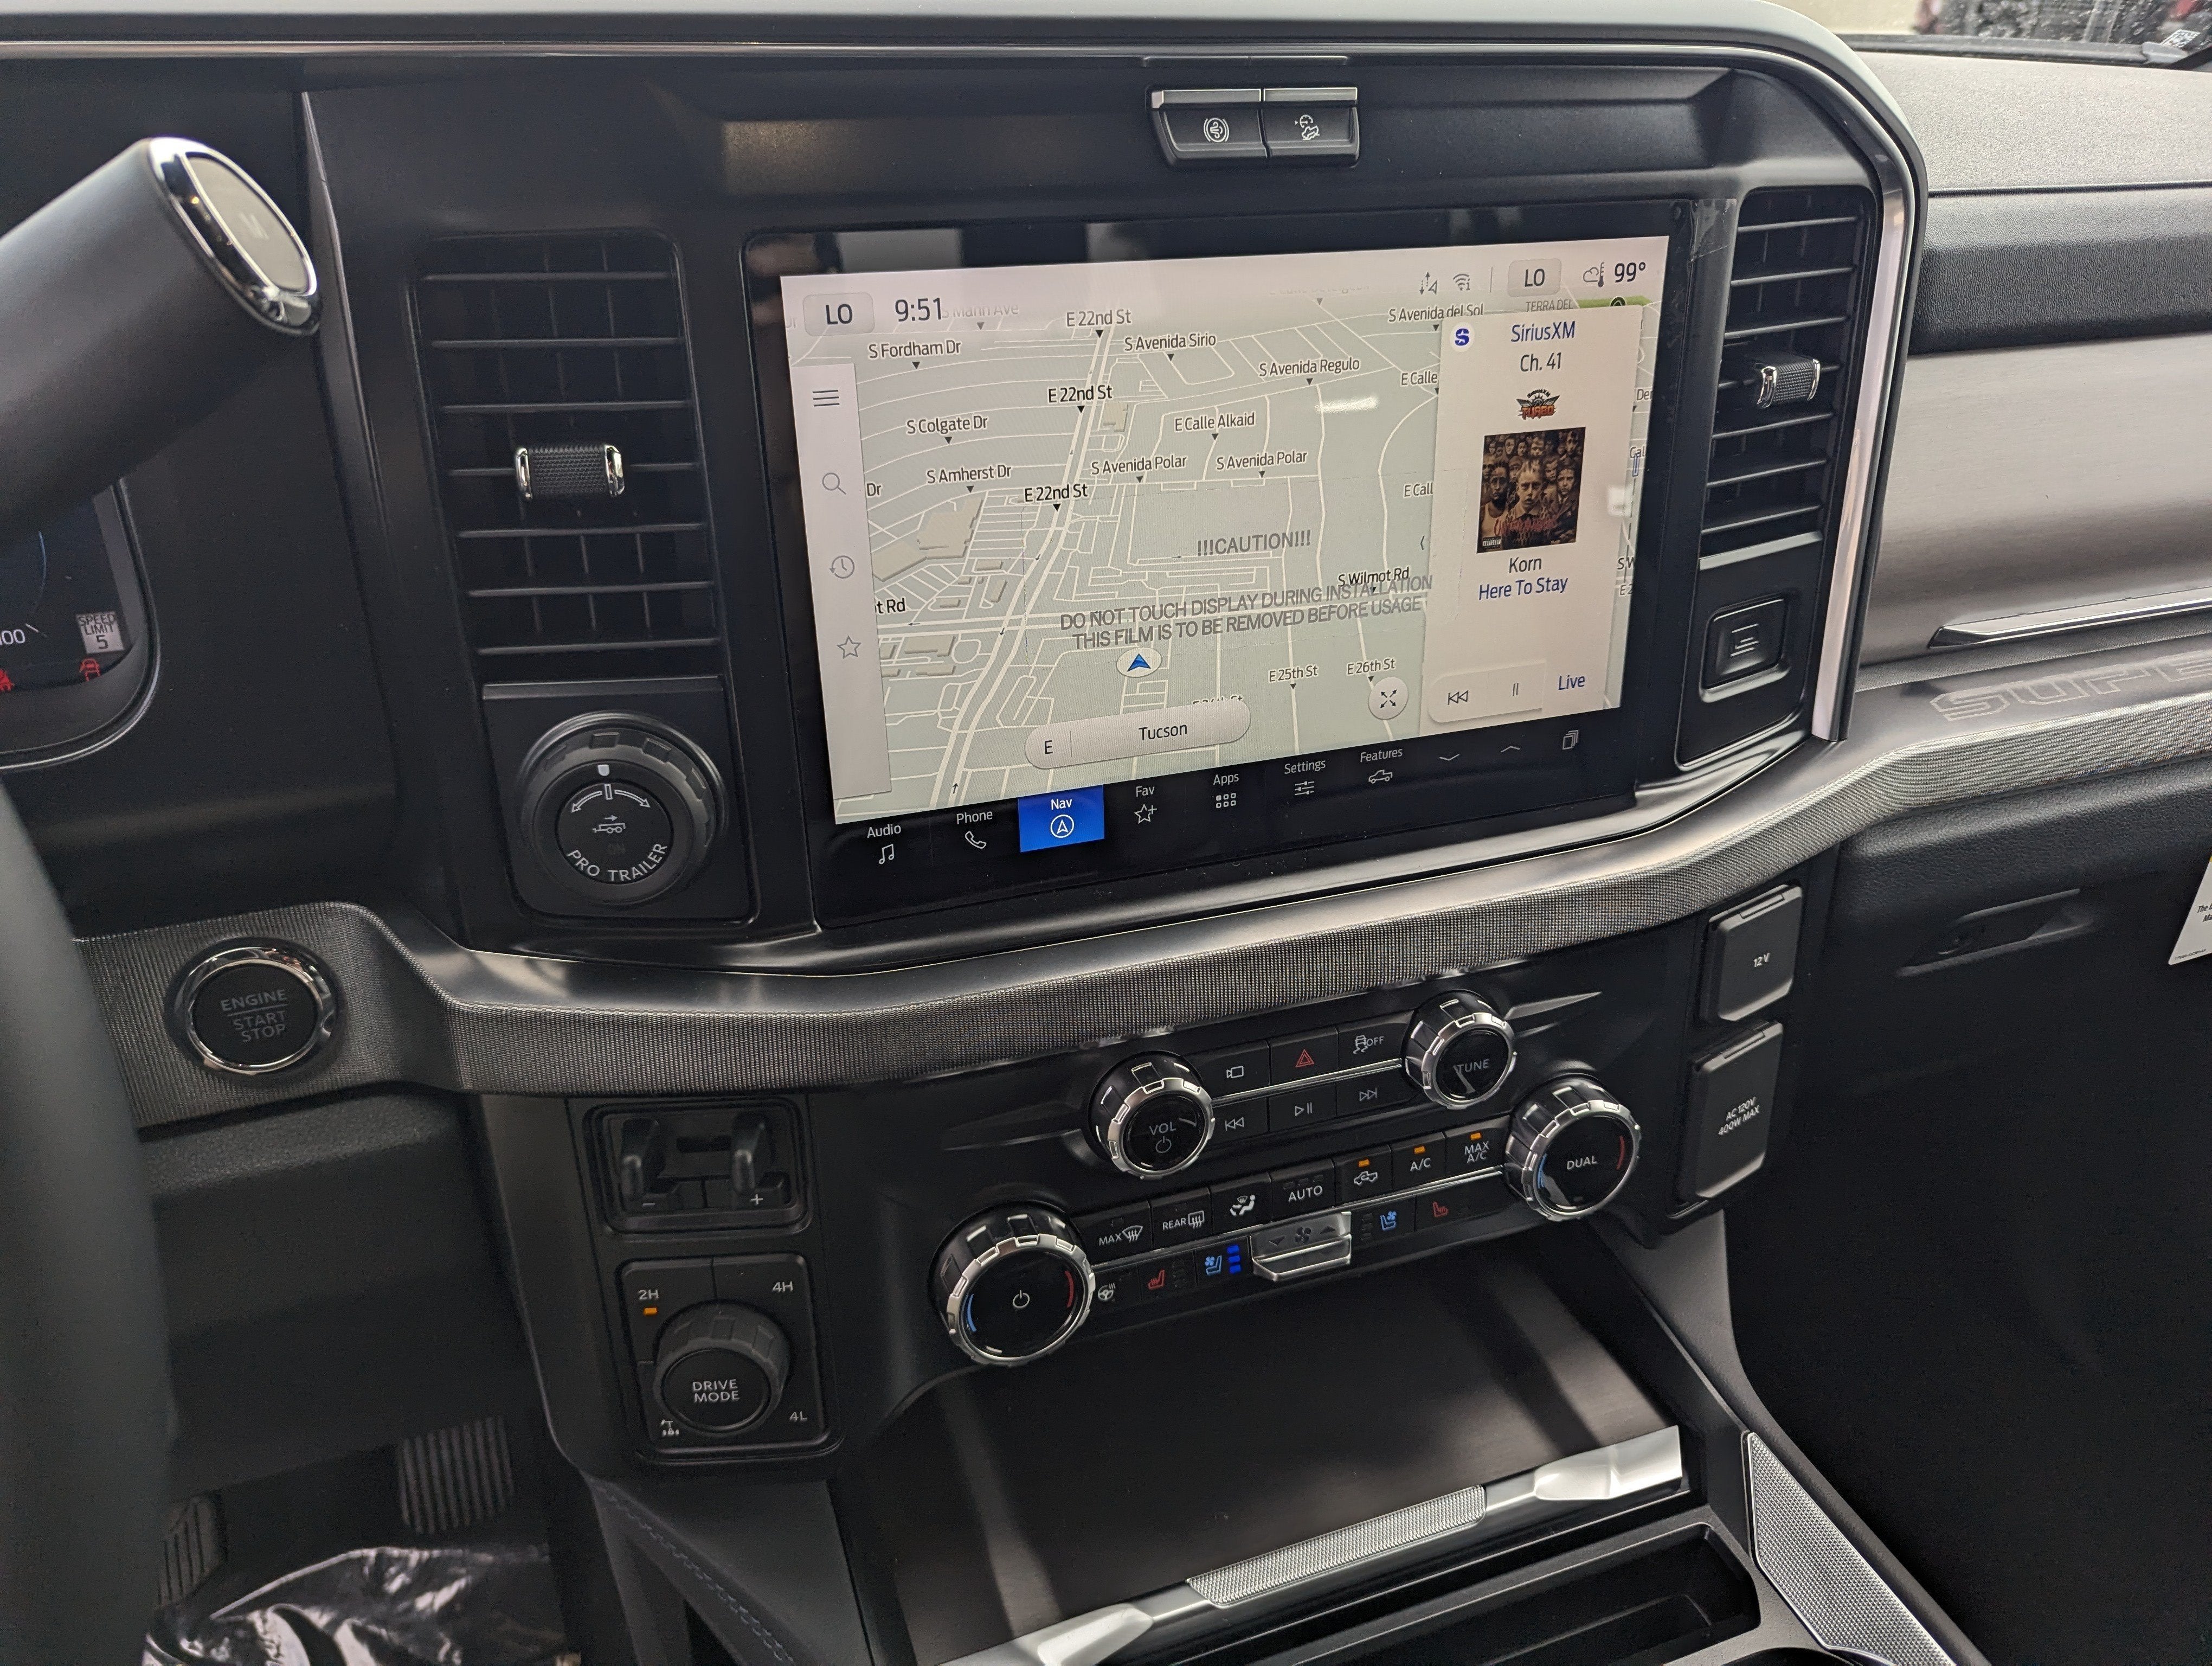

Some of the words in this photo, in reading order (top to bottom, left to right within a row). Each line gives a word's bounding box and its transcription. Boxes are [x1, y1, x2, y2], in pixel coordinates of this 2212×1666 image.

[1524, 268, 1545, 287] LO
[826, 303, 852, 324] LO
[895, 297, 942, 322] 9:51
[994, 305, 1018, 316] Ave
[1389, 309, 1396, 321] S
[1399, 305, 1444, 321] Avenida
[1446, 306, 1464, 316] del
[1467, 304, 1483, 316] Sol
[1526, 300, 1554, 312] TERRA
[1557, 299, 1573, 310] DEL
[1066, 313, 1075, 326] E
[1078, 310, 1113, 325] 22nd
[1117, 309, 1131, 323] St
[1510, 321, 1576, 343] SiriusXM
[869, 345, 877, 358] S
[881, 341, 943, 357] Fordham
[947, 341, 961, 354] Dr
[1124, 338, 1133, 350] S
[1135, 334, 1186, 350] Avenida
[1189, 333, 1216, 347] Sirio
[1259, 363, 1267, 376] S
[1270, 360, 1317, 375] Avenida
[1321, 357, 1360, 373] Regulo
[1520, 354, 1542, 371] Ch.
[1546, 352, 1562, 370] 41
[1401, 374, 1408, 386] E
[1410, 372, 1437, 385] Calle
[1049, 389, 1057, 402] E
[1059, 386, 1094, 401] 22nd
[1097, 385, 1112, 399] St
[907, 421, 915, 434] S
[918, 416, 970, 434] Colgate
[974, 415, 988, 428] Dr
[1175, 418, 1182, 431] E
[1185, 416, 1214, 430] Calle
[1218, 413, 1255, 428] Alkaid
[1091, 462, 1099, 475] S
[1102, 458, 1152, 473] Avenida
[1155, 456, 1187, 470] Polar
[1217, 457, 1224, 470] S
[1227, 453, 1274, 469] Avenida
[1277, 451, 1307, 465] Polar
[927, 471, 935, 484] S
[938, 466, 994, 483] Amherst
[997, 465, 1012, 478] Dr
[867, 483, 881, 496] Dr
[1025, 488, 1033, 502] E
[1036, 485, 1070, 501] 22nd
[1073, 484, 1088, 498] St
[1404, 485, 1410, 496] E
[1197, 530, 1310, 556] !!!CAUTION!!!
[1509, 558, 1542, 573] Korn
[1617, 558, 1624, 569] S
[1338, 574, 1345, 586] S
[1349, 569, 1391, 585] Wilmot
[1394, 566, 1410, 580] Rd
[1479, 582, 1512, 600] Here
[1516, 580, 1532, 595] To
[1536, 576, 1568, 594] Stay
[1620, 585, 1626, 595] E
[886, 598, 905, 613] Rd
[1061, 613, 1085, 631] DO
[1090, 608, 1127, 627] NOT
[1128, 603, 1187, 623] TOUCH
[1192, 592, 1258, 616] DISPLAY
[1262, 586, 1322, 609] DURING
[1326, 574, 1432, 601] INSTALLATION
[78, 613, 116, 626] SPEED
[1072, 630, 1110, 650] THIS
[1115, 626, 1153, 646] FILM
[1158, 624, 1172, 640] IS
[1176, 620, 1198, 638] TO
[1202, 617, 1223, 636] BE
[1227, 608, 1303, 633] REMOVED
[1308, 601, 1368, 624] BEFORE
[1371, 595, 1422, 616] USAGE
[84, 624, 113, 636] LIMIT
[96, 635, 108, 649] 5
[1269, 670, 1276, 683] E
[1278, 667, 1303, 681] 25th
[1306, 665, 1318, 678] St
[1347, 663, 1354, 675] E
[1356, 660, 1383, 674] 26th
[1385, 658, 1396, 670] St
[1558, 674, 1585, 691] Live
[1139, 724, 1187, 741] Tucson
[1044, 741, 1052, 754] E
[1360, 747, 1403, 762] Features
[1284, 759, 1326, 774] Settings
[1213, 772, 1239, 786] Apps
[1136, 785, 1155, 797] Fav
[1051, 798, 1072, 810] Nav
[956, 810, 993, 824] Phone
[867, 823, 901, 839] Audio
[567, 849, 600, 876] PRO
[608, 843, 667, 882] TRAILER
[2197, 905, 2208, 913] The
[221, 989, 288, 1011] ENGINE
[234, 1011, 286, 1030] START
[241, 1024, 286, 1042] STOP
[1367, 1036, 1384, 1047] OFF
[1457, 1059, 1489, 1075] TUNE
[1726, 1108, 1737, 1121] AC
[1738, 1097, 1756, 1113] 120V
[1150, 1120, 1176, 1135] VOL
[1719, 1116, 1741, 1135] 400W
[1742, 1105, 1760, 1123] MAX
[1464, 1142, 1490, 1156] MAX
[1467, 1150, 1488, 1163] A/C
[1410, 1158, 1431, 1171] A/C
[1566, 1154, 1598, 1170] DUAL
[1288, 1184, 1323, 1202] AUTO
[1162, 1216, 1188, 1231] REAR
[1098, 1234, 1123, 1246] MAX
[639, 1289, 659, 1299] 2H
[772, 1281, 793, 1292] 4H
[692, 1379, 738, 1392] DRIVE
[693, 1390, 740, 1404] MODE
[789, 1411, 807, 1421] 4L
